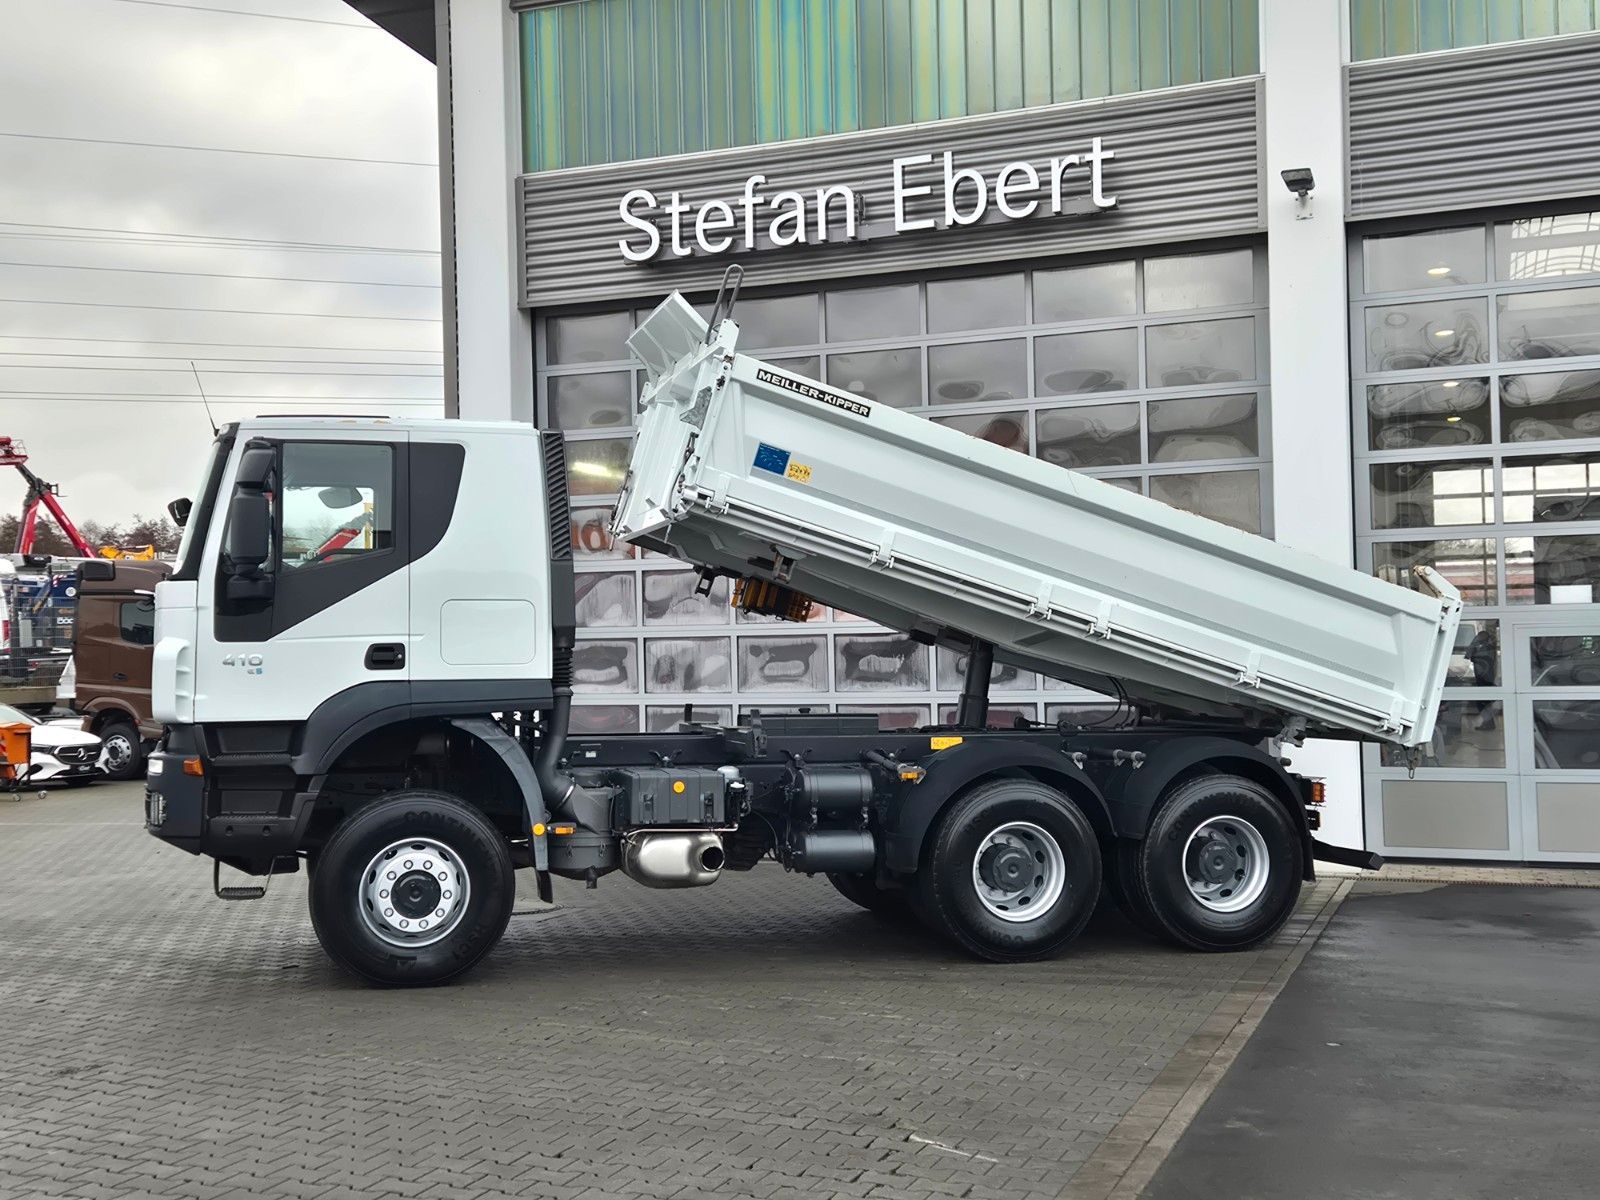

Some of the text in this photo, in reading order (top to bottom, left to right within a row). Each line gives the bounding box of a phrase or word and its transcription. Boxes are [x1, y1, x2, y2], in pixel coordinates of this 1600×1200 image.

[618, 136, 1118, 262] Stefan Ebert
[758, 369, 869, 417] MEILLER-KIPPER
[222, 653, 263, 667] 410
